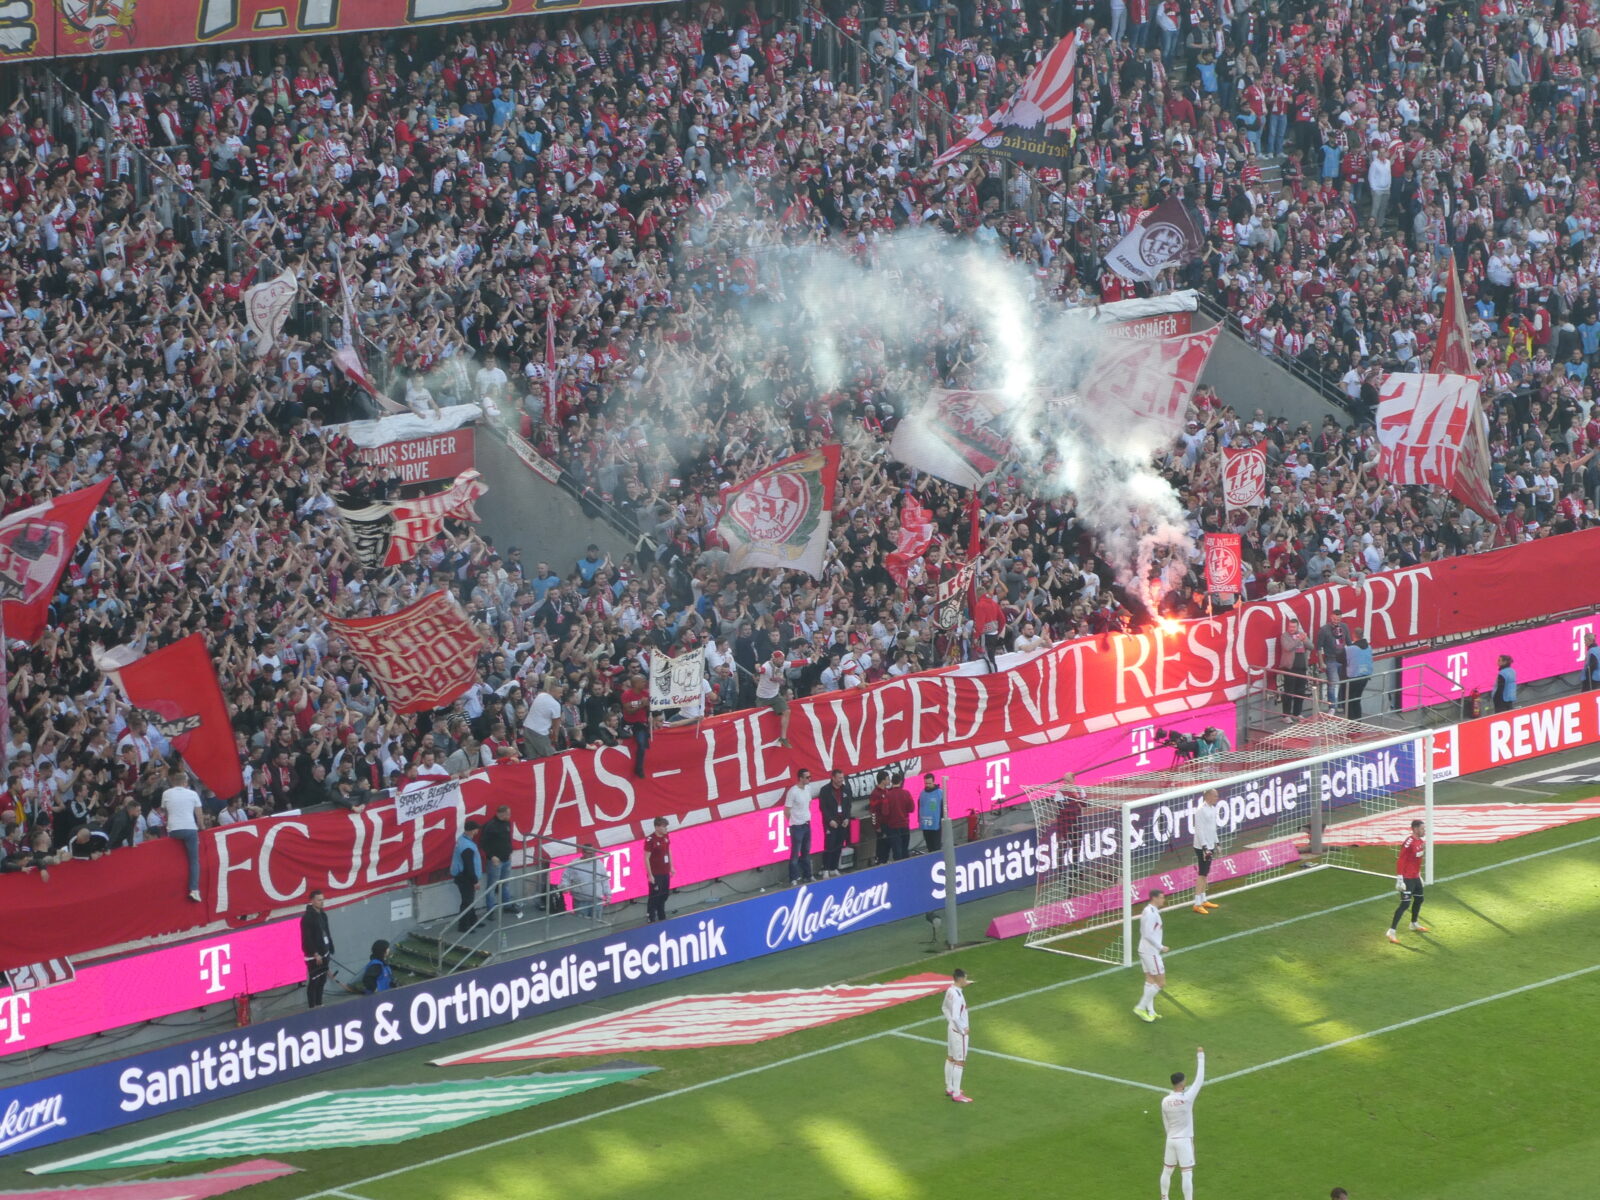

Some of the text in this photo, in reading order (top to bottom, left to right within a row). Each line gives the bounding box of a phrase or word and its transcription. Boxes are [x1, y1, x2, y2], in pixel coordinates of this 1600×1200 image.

[1134, 317, 1177, 340] SCHÄFER
[401, 436, 456, 461] SCHÄFER
[1490, 702, 1582, 763] REWE
[214, 821, 310, 913] FC
[513, 744, 635, 842] JAS
[703, 707, 791, 801] HE
[800, 676, 988, 772] WEED
[1004, 640, 1101, 733] NIT
[986, 758, 1010, 801] T
[1152, 751, 1400, 842] Ortopädie-echnik
[200, 943, 230, 994] T
[119, 882, 892, 1112] Sanitätshaus & Orthopädie-Technik Malzkorn
